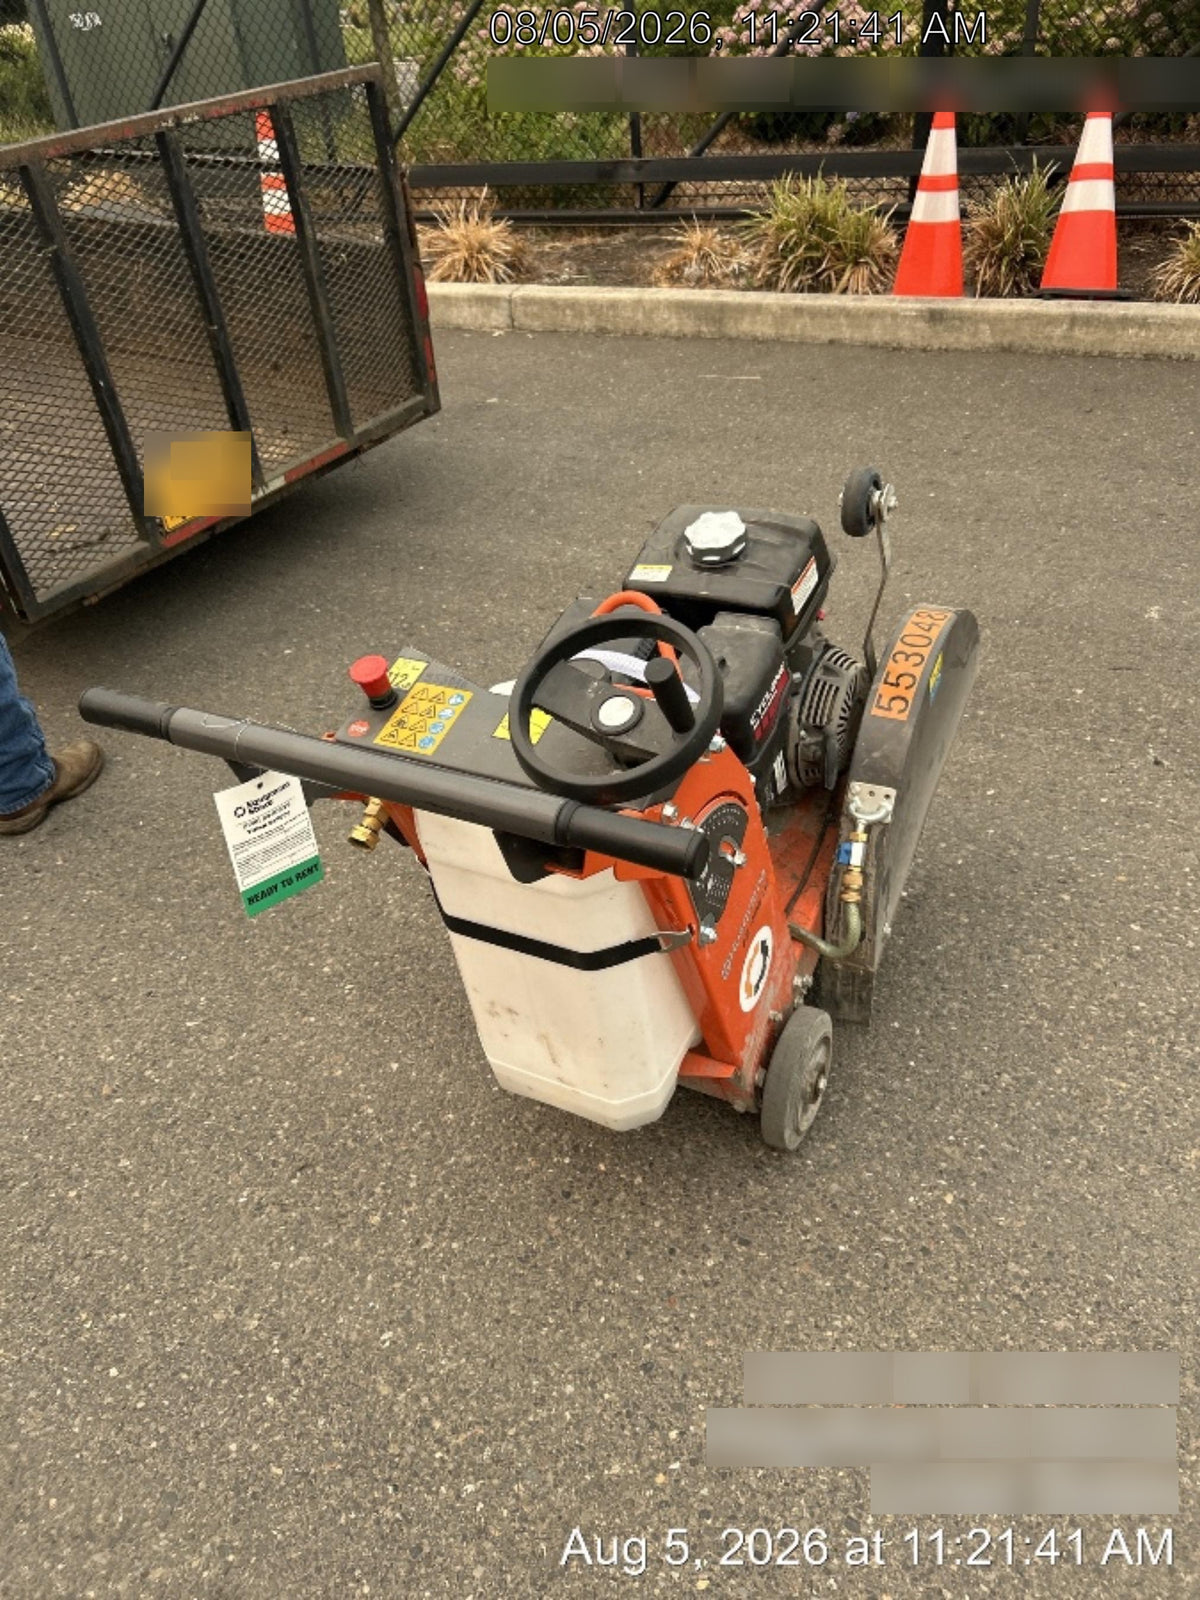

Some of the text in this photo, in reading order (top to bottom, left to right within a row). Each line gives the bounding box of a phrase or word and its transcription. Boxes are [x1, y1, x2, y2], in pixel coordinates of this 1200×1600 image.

[246, 862, 319, 906] READY TO RENT
